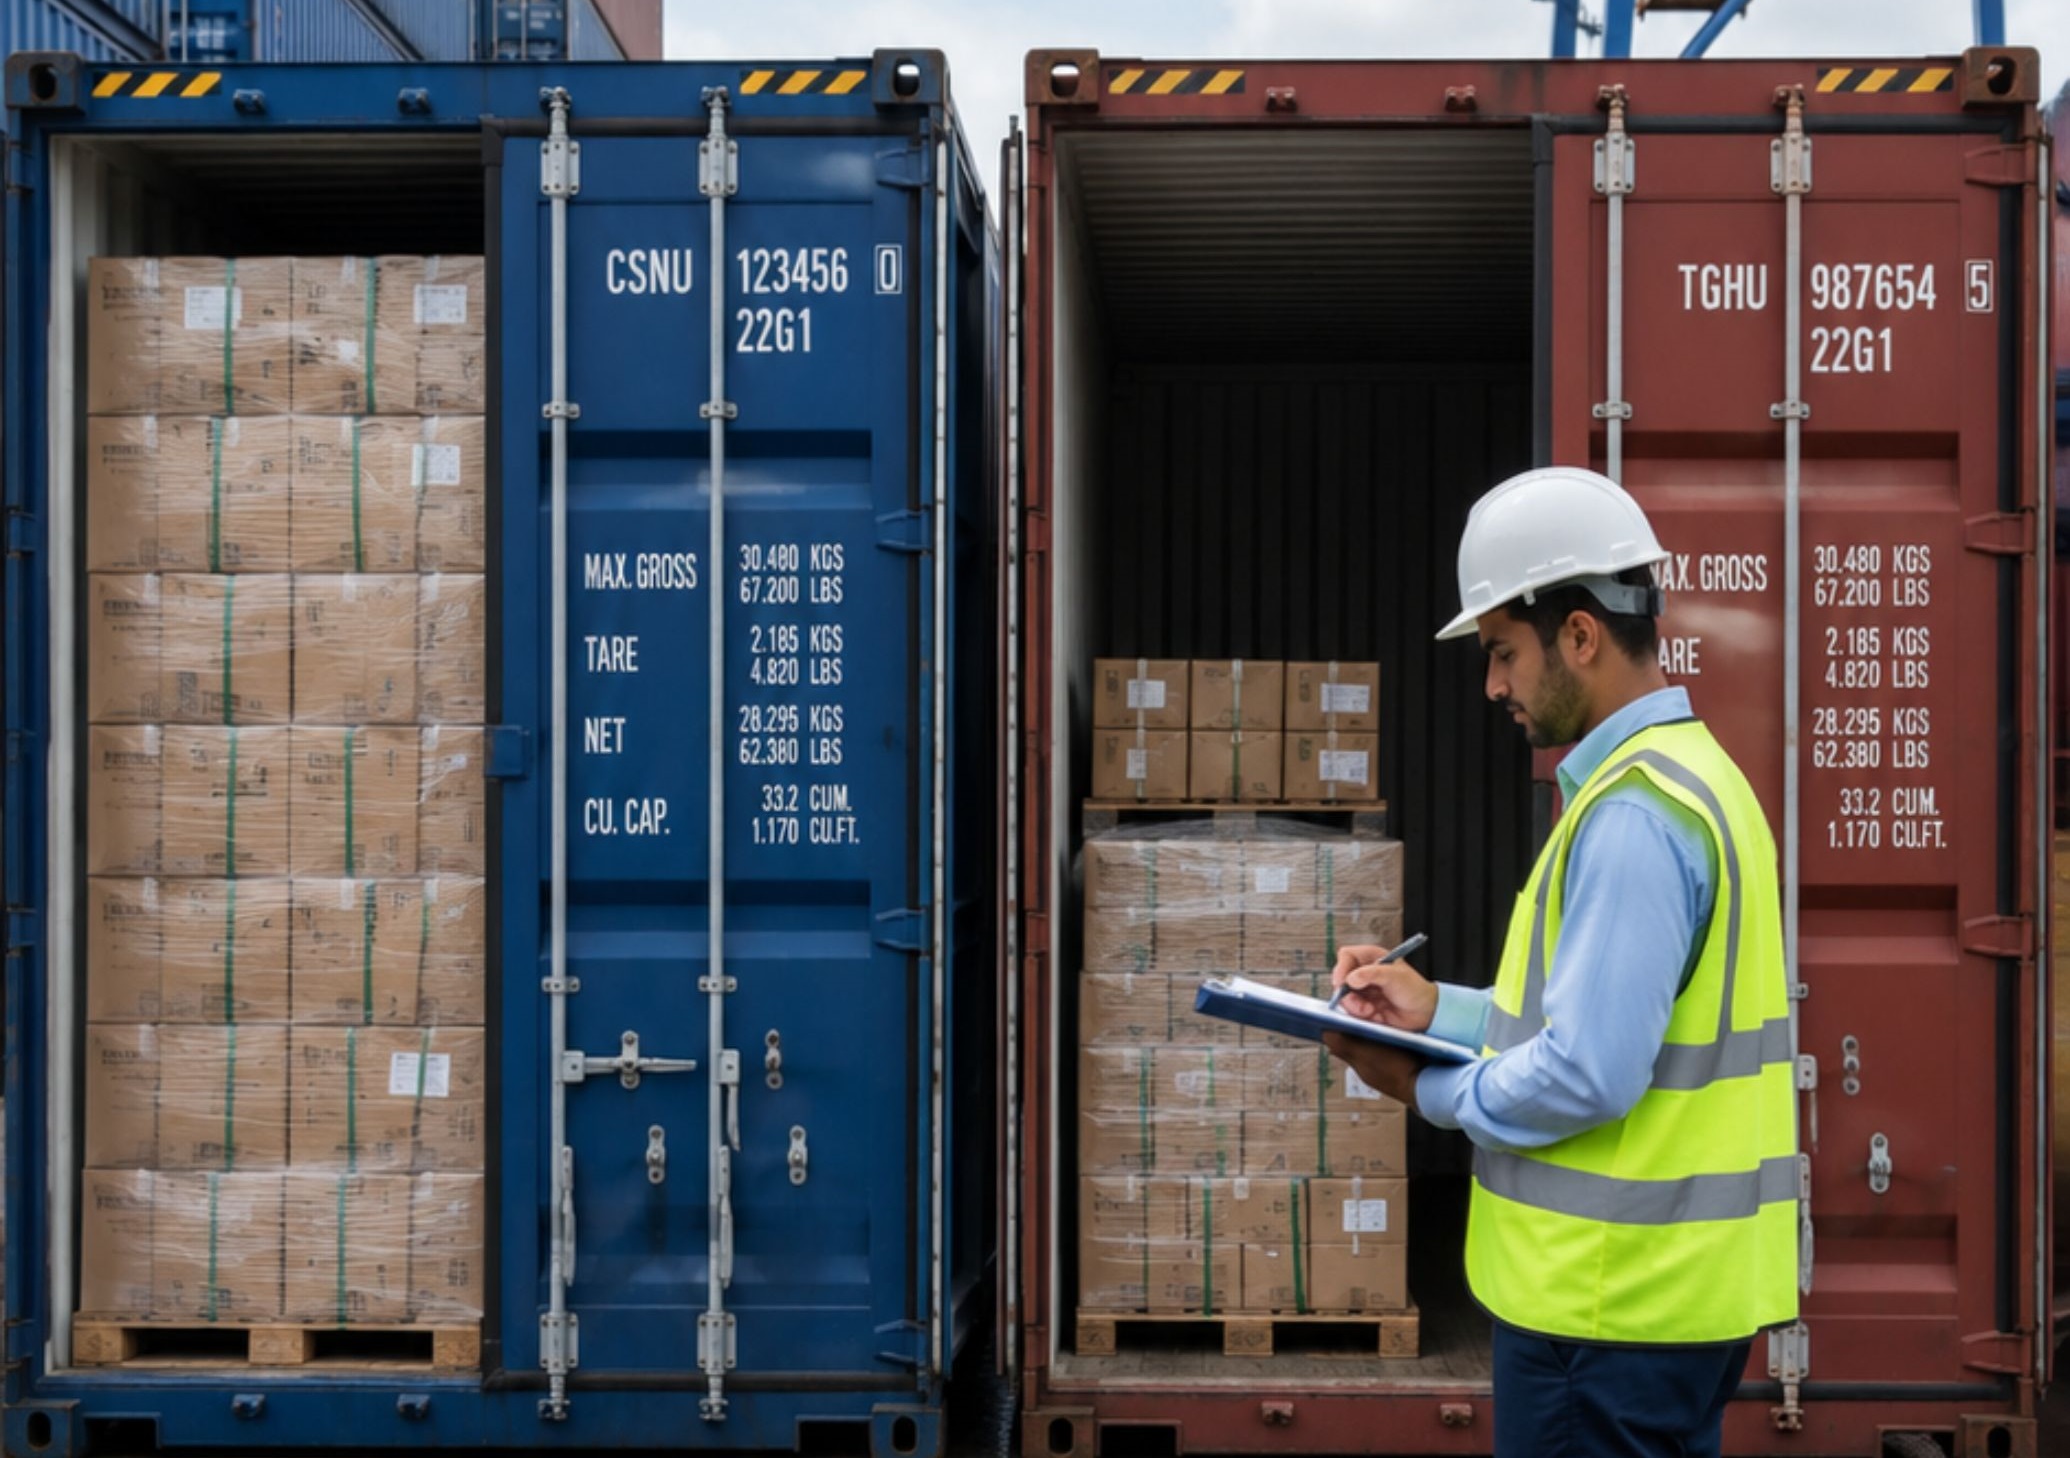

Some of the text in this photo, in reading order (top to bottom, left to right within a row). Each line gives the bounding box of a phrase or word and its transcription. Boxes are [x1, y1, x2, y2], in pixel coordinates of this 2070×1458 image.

[606, 247, 897, 295] CSNU 123456 0
[1678, 262, 1989, 311] TGHU 987654 5
[736, 306, 812, 353] 22G1
[1810, 325, 1892, 374] 22G1
[584, 552, 698, 590] MAX. GROSS
[740, 543, 845, 572] 30.480 KGS
[1814, 544, 1931, 575] 30.480 KGS
[1699, 554, 1768, 592] GROSS
[740, 575, 844, 604] 67.200 LBS
[1814, 577, 1931, 607] 67.200 LBS
[750, 624, 844, 653] 2.185 KGS
[1825, 626, 1930, 656] 2.185 KGS
[584, 635, 639, 673] TARE
[1658, 636, 1702, 675] ARE
[749, 656, 843, 685] 4.820 LBS
[1825, 659, 1929, 689] 4.820 LBS
[739, 704, 844, 733] 28.295 KGS
[1813, 706, 1930, 736] 28.295 KGS
[584, 716, 626, 754] NET
[738, 737, 843, 765] 62.380 LBS
[1813, 739, 1929, 769] 62.380 LBS
[761, 783, 853, 812] 33.2 CUM.
[1839, 786, 1940, 817] 33.2 CUM.
[584, 798, 671, 836] CU. CAP.
[752, 816, 800, 845] 1.170
[1828, 819, 1881, 849] 1.170
